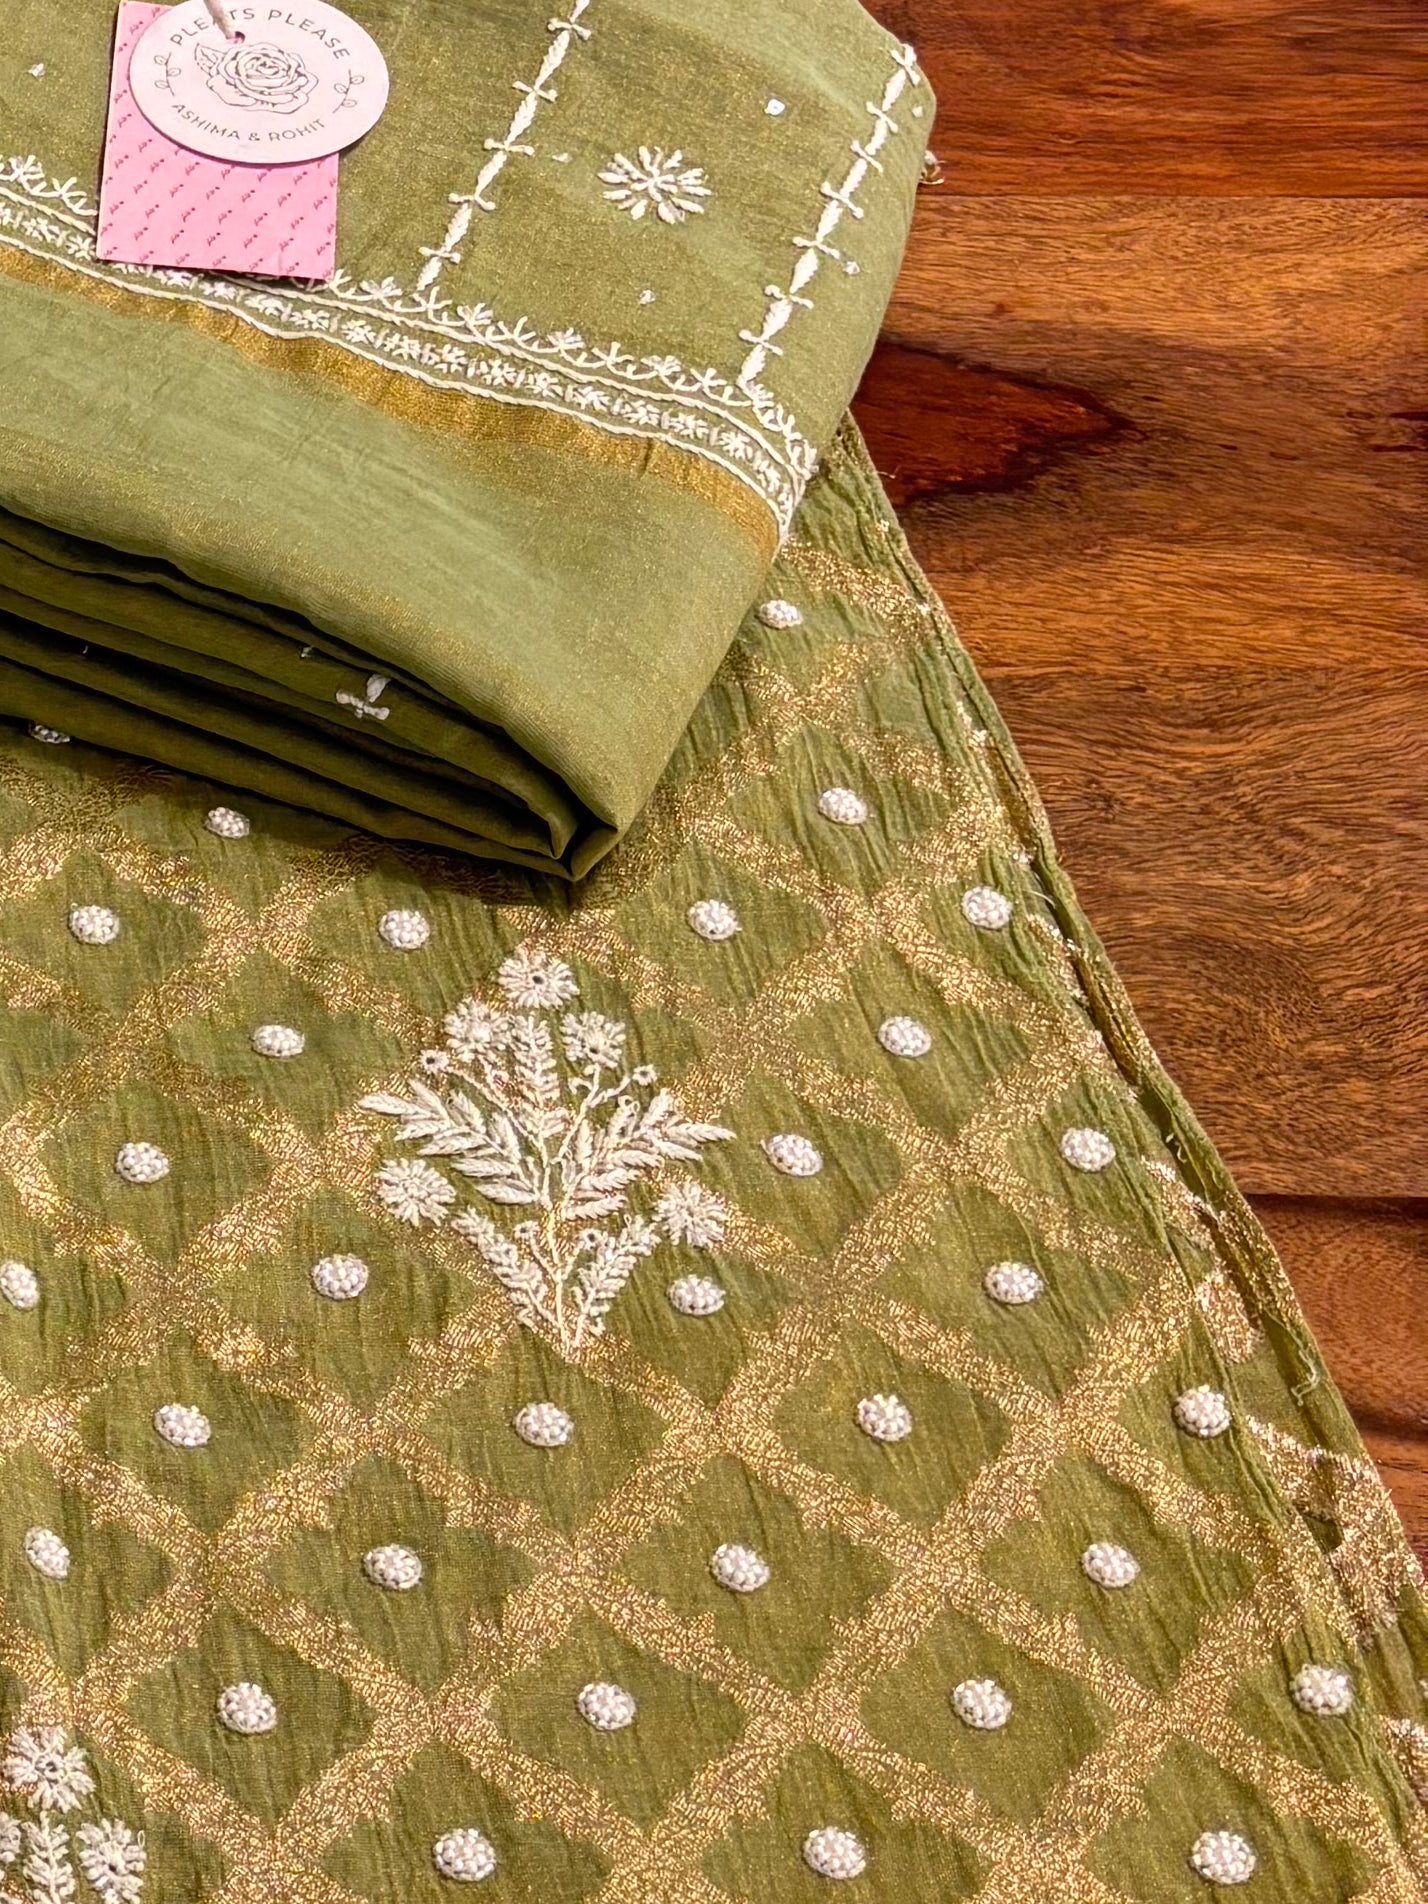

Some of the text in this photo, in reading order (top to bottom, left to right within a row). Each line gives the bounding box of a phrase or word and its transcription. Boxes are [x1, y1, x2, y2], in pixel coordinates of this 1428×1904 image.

[169, 7, 351, 59] PLETS PLEASE
[171, 103, 326, 142] ASHIMA & ROHIT
